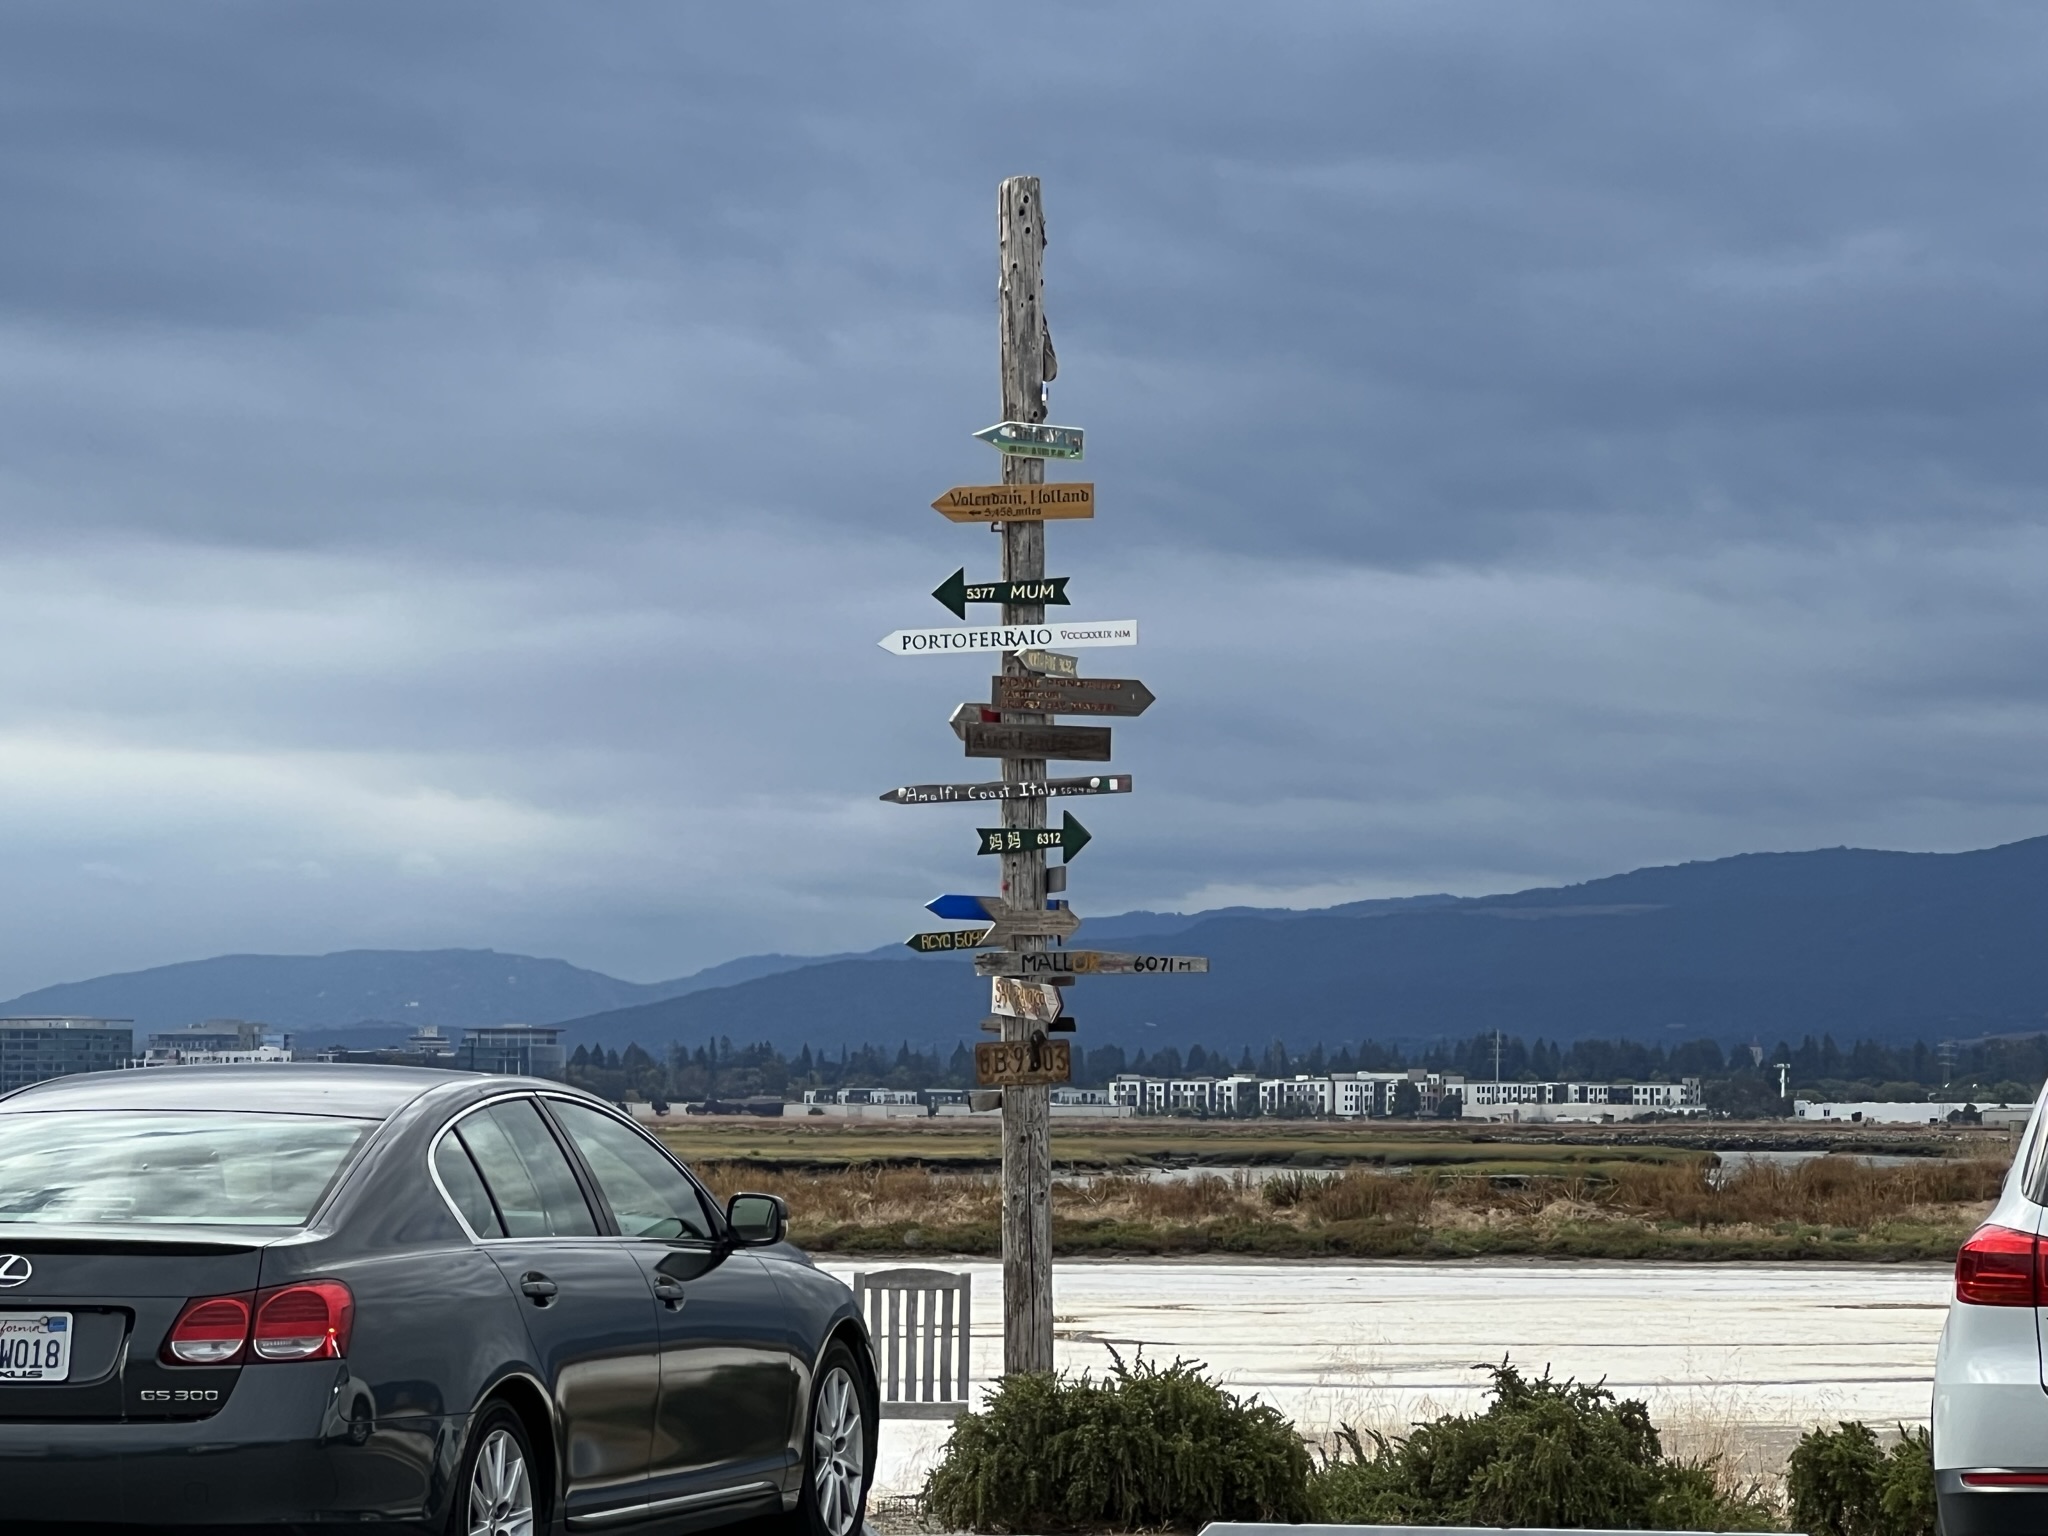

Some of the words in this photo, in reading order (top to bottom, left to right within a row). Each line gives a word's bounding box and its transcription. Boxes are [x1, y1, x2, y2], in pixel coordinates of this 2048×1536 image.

[1031, 489, 1089, 504] Holland
[966, 587, 996, 600] 5377
[1010, 584, 1054, 599] MUM
[902, 629, 1052, 650] PORTOFERRAIO
[906, 786, 958, 802] Amalfi
[968, 784, 1010, 799] Coast
[1018, 781, 1057, 797] Italy
[989, 831, 1021, 851] 妈妈
[1037, 832, 1061, 845] 6312
[1134, 956, 1173, 973] 6071
[141, 1390, 170, 1401] GS
[174, 1390, 218, 1401] 300
